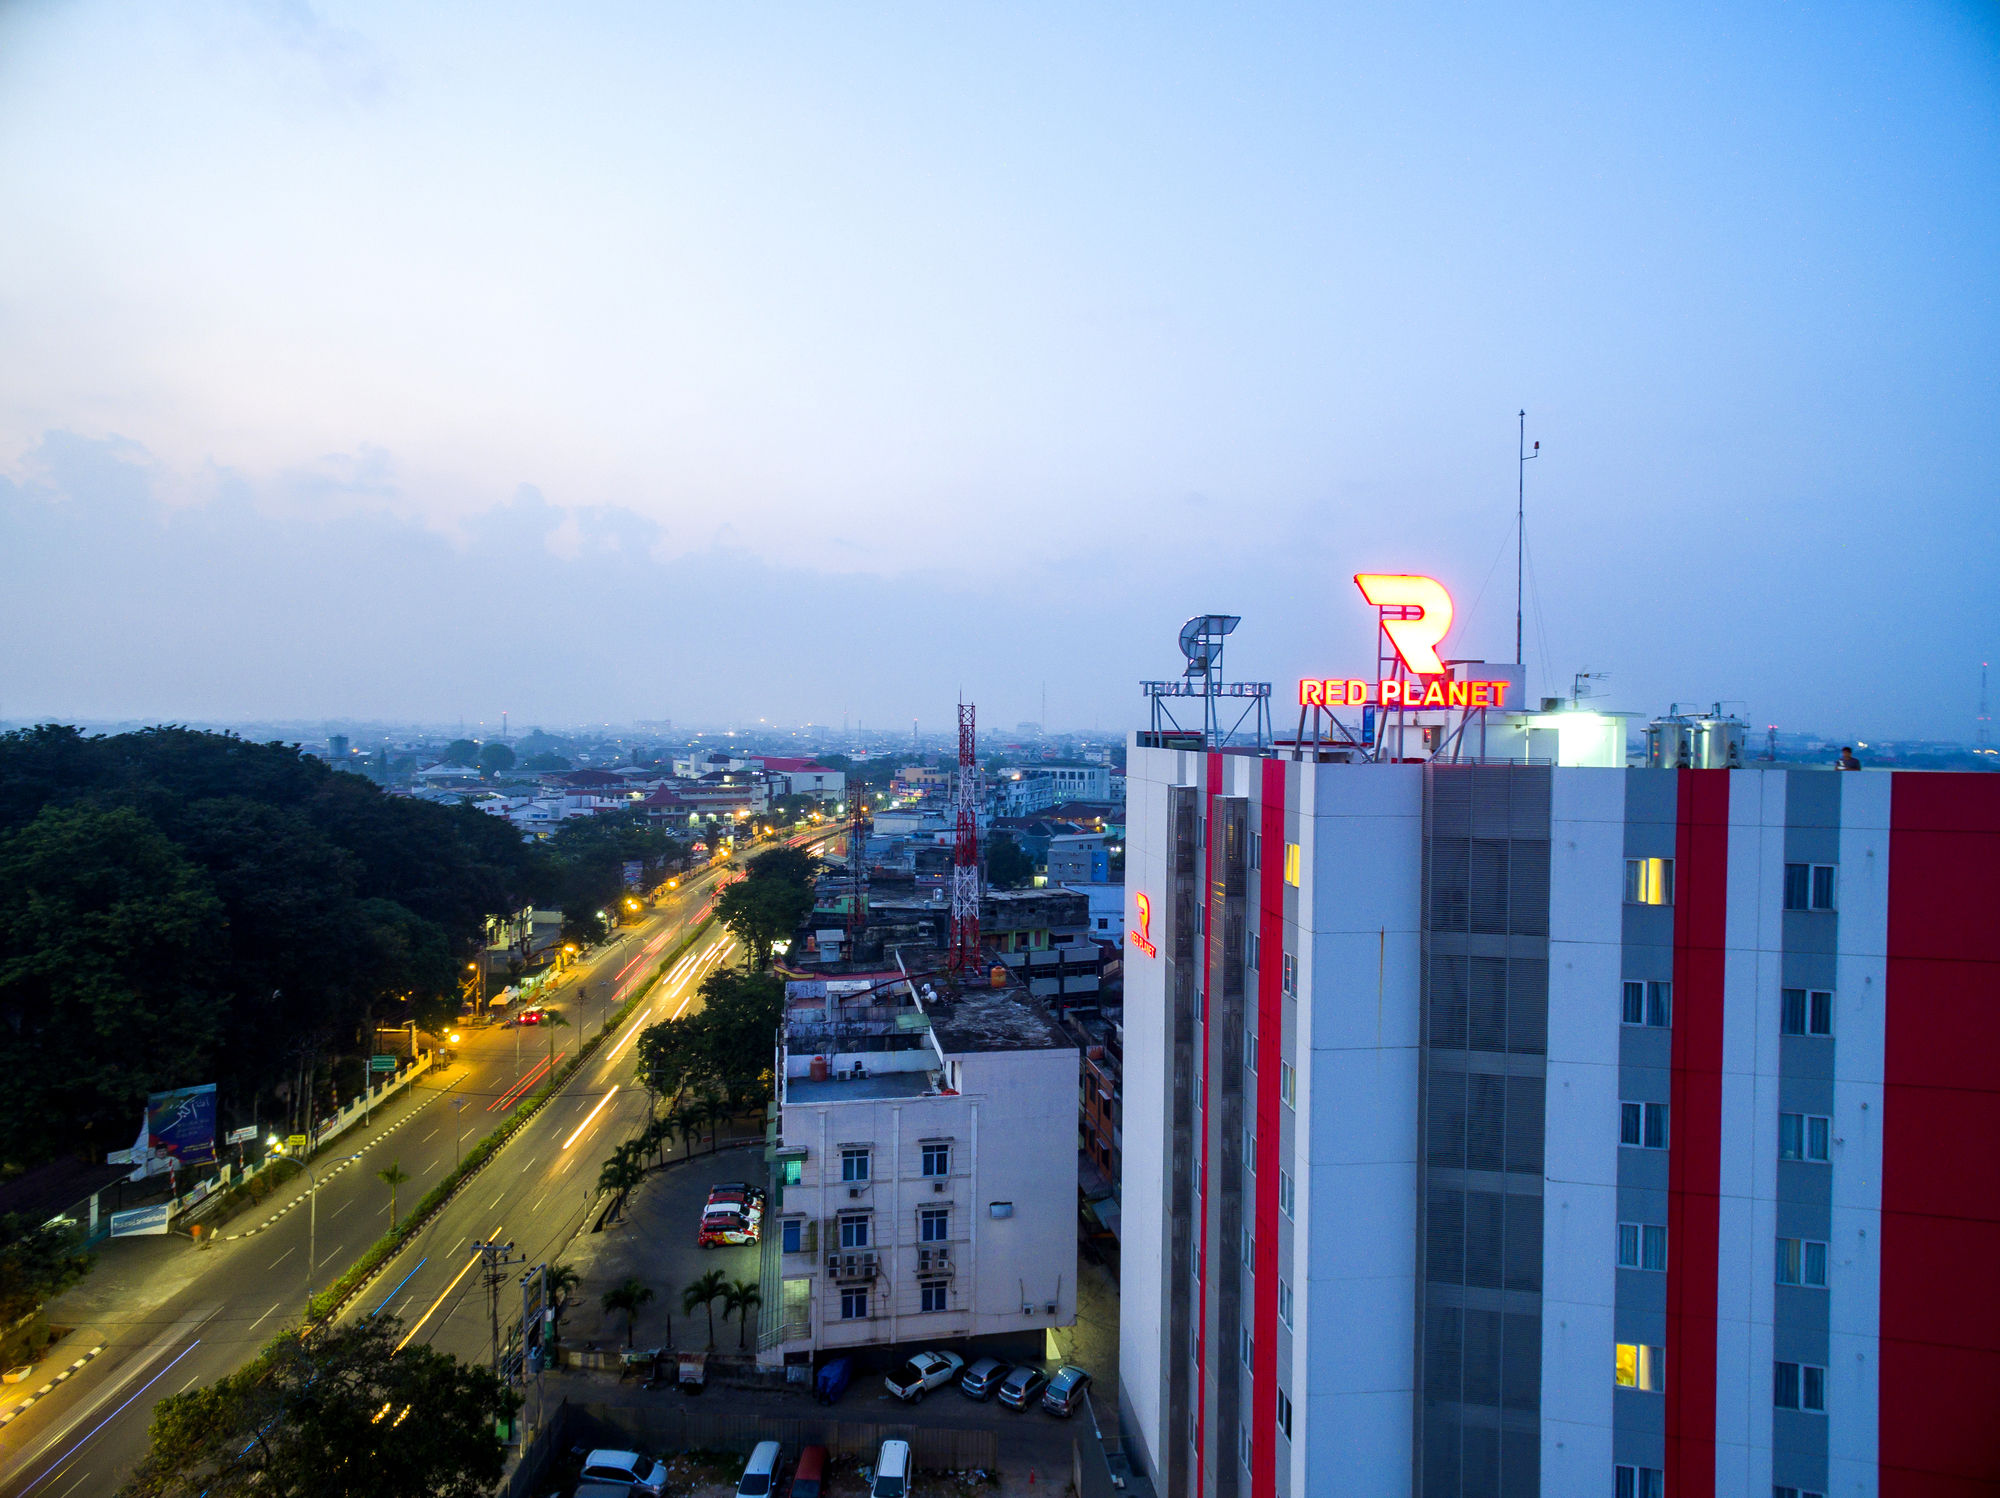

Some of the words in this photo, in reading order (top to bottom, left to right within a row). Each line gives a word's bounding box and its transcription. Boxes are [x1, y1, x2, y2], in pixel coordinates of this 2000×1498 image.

[1353, 574, 1454, 674] R
[1299, 679, 1368, 706] RED
[1378, 679, 1511, 707] PLANET
